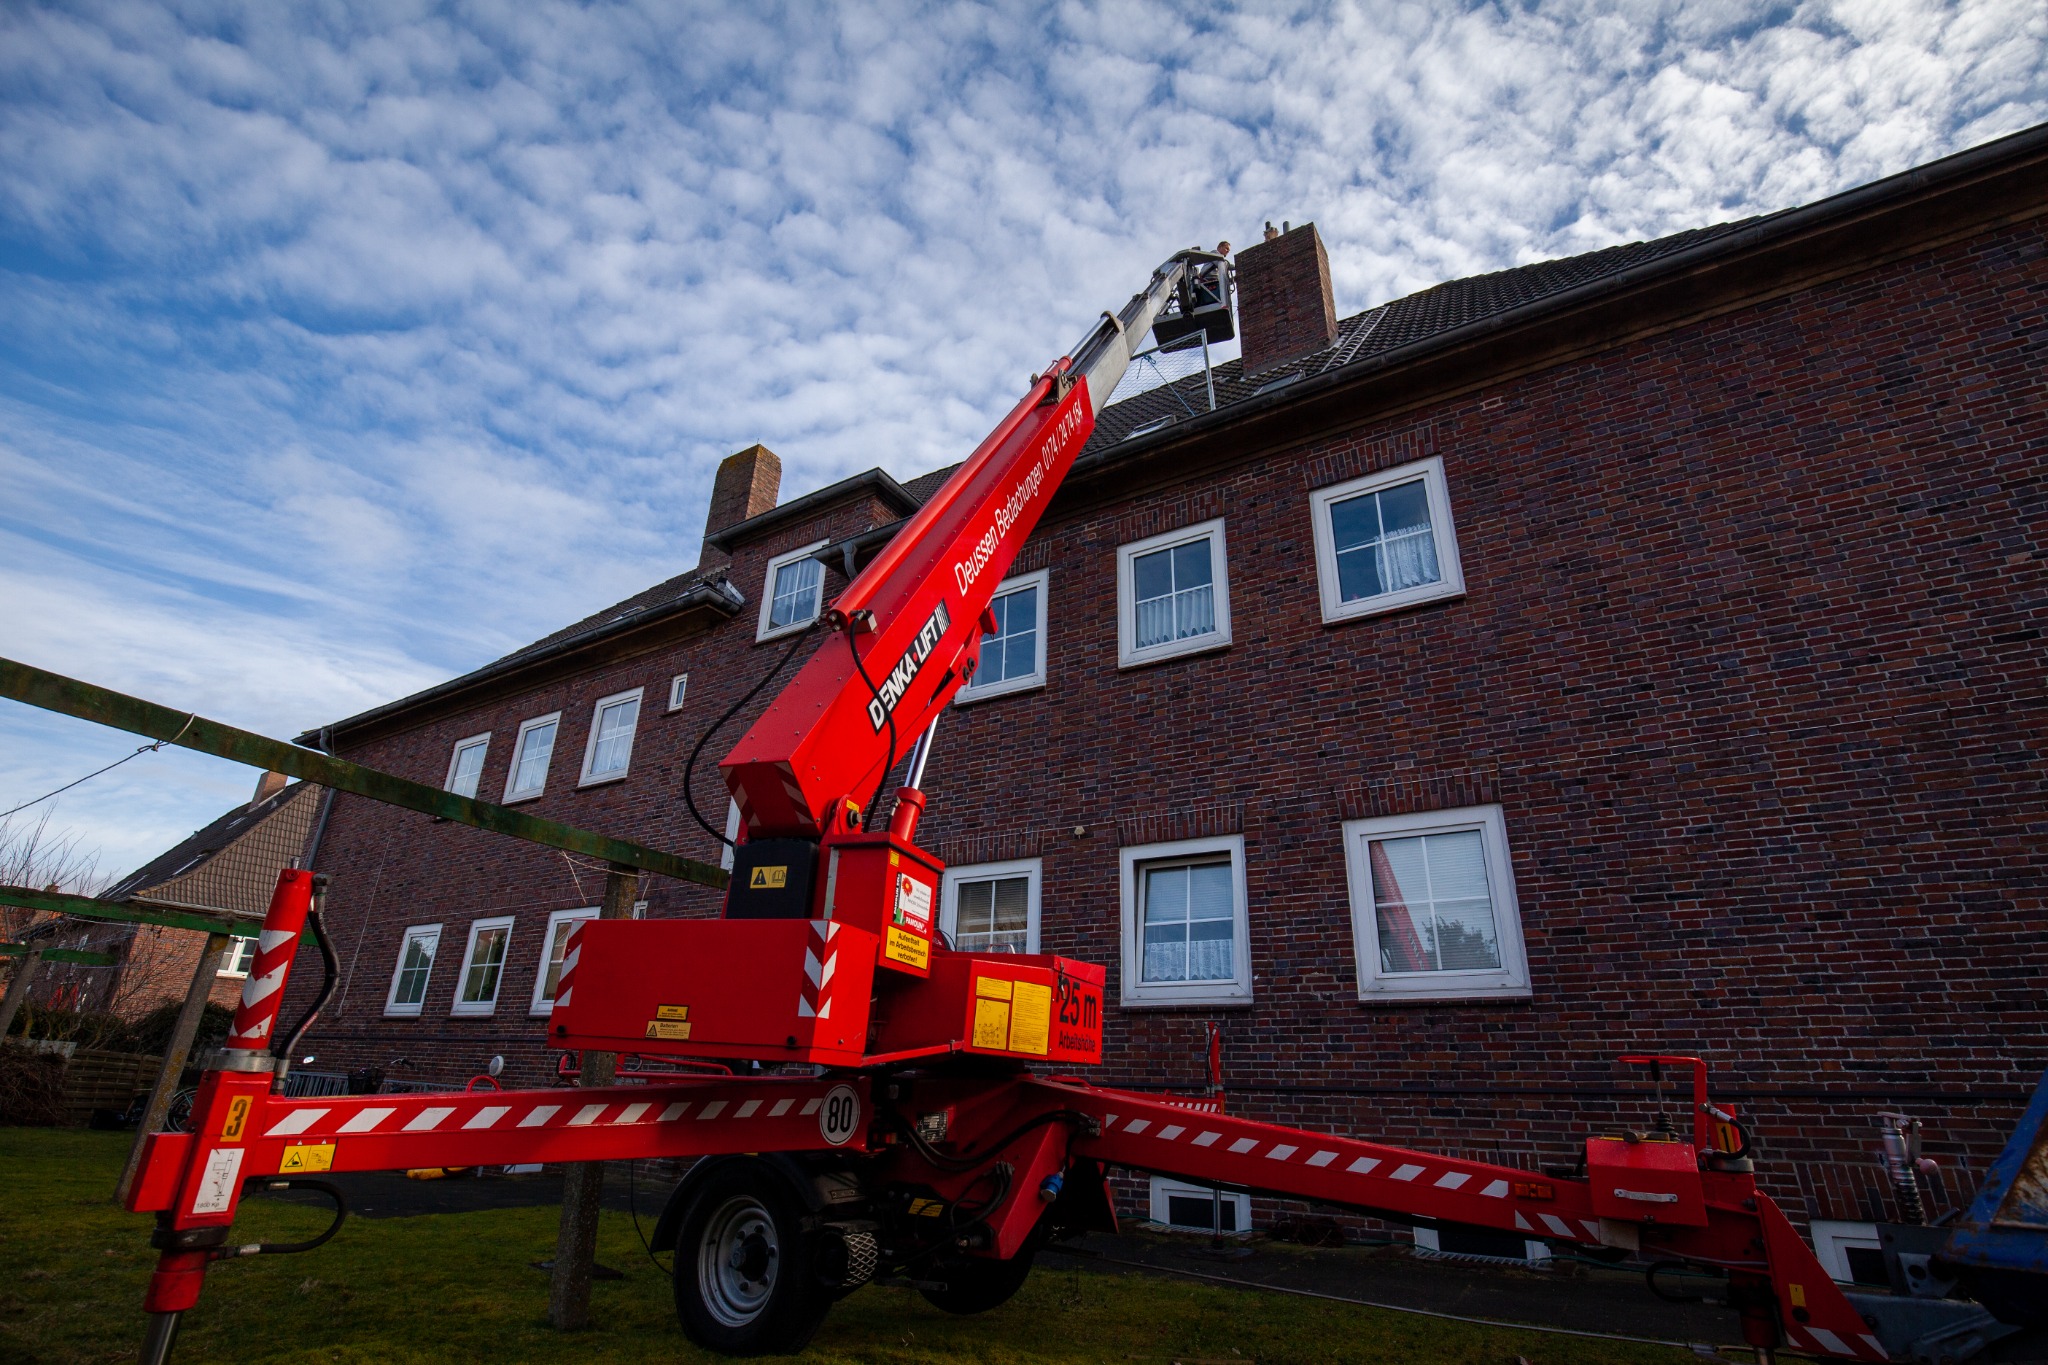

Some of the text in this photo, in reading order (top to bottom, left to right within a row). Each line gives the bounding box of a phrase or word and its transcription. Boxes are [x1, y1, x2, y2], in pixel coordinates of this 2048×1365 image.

[954, 525, 999, 597] Deussen
[994, 461, 1045, 539] Bedachungen
[1041, 433, 1059, 471] 0174
[1059, 419, 1069, 447] 24
[1065, 410, 1075, 437] 74
[889, 939, 926, 957] im Arbeitsbereich
[897, 932, 920, 947] Aufenthalt
[897, 952, 918, 964] verboten!
[1056, 977, 1080, 1027] 25
[1083, 994, 1097, 1029] m
[1058, 1030, 1096, 1053] Arbeitshöhe
[226, 1098, 248, 1137] 3
[826, 1094, 852, 1134] 80
[1720, 1126, 1731, 1153] 1
